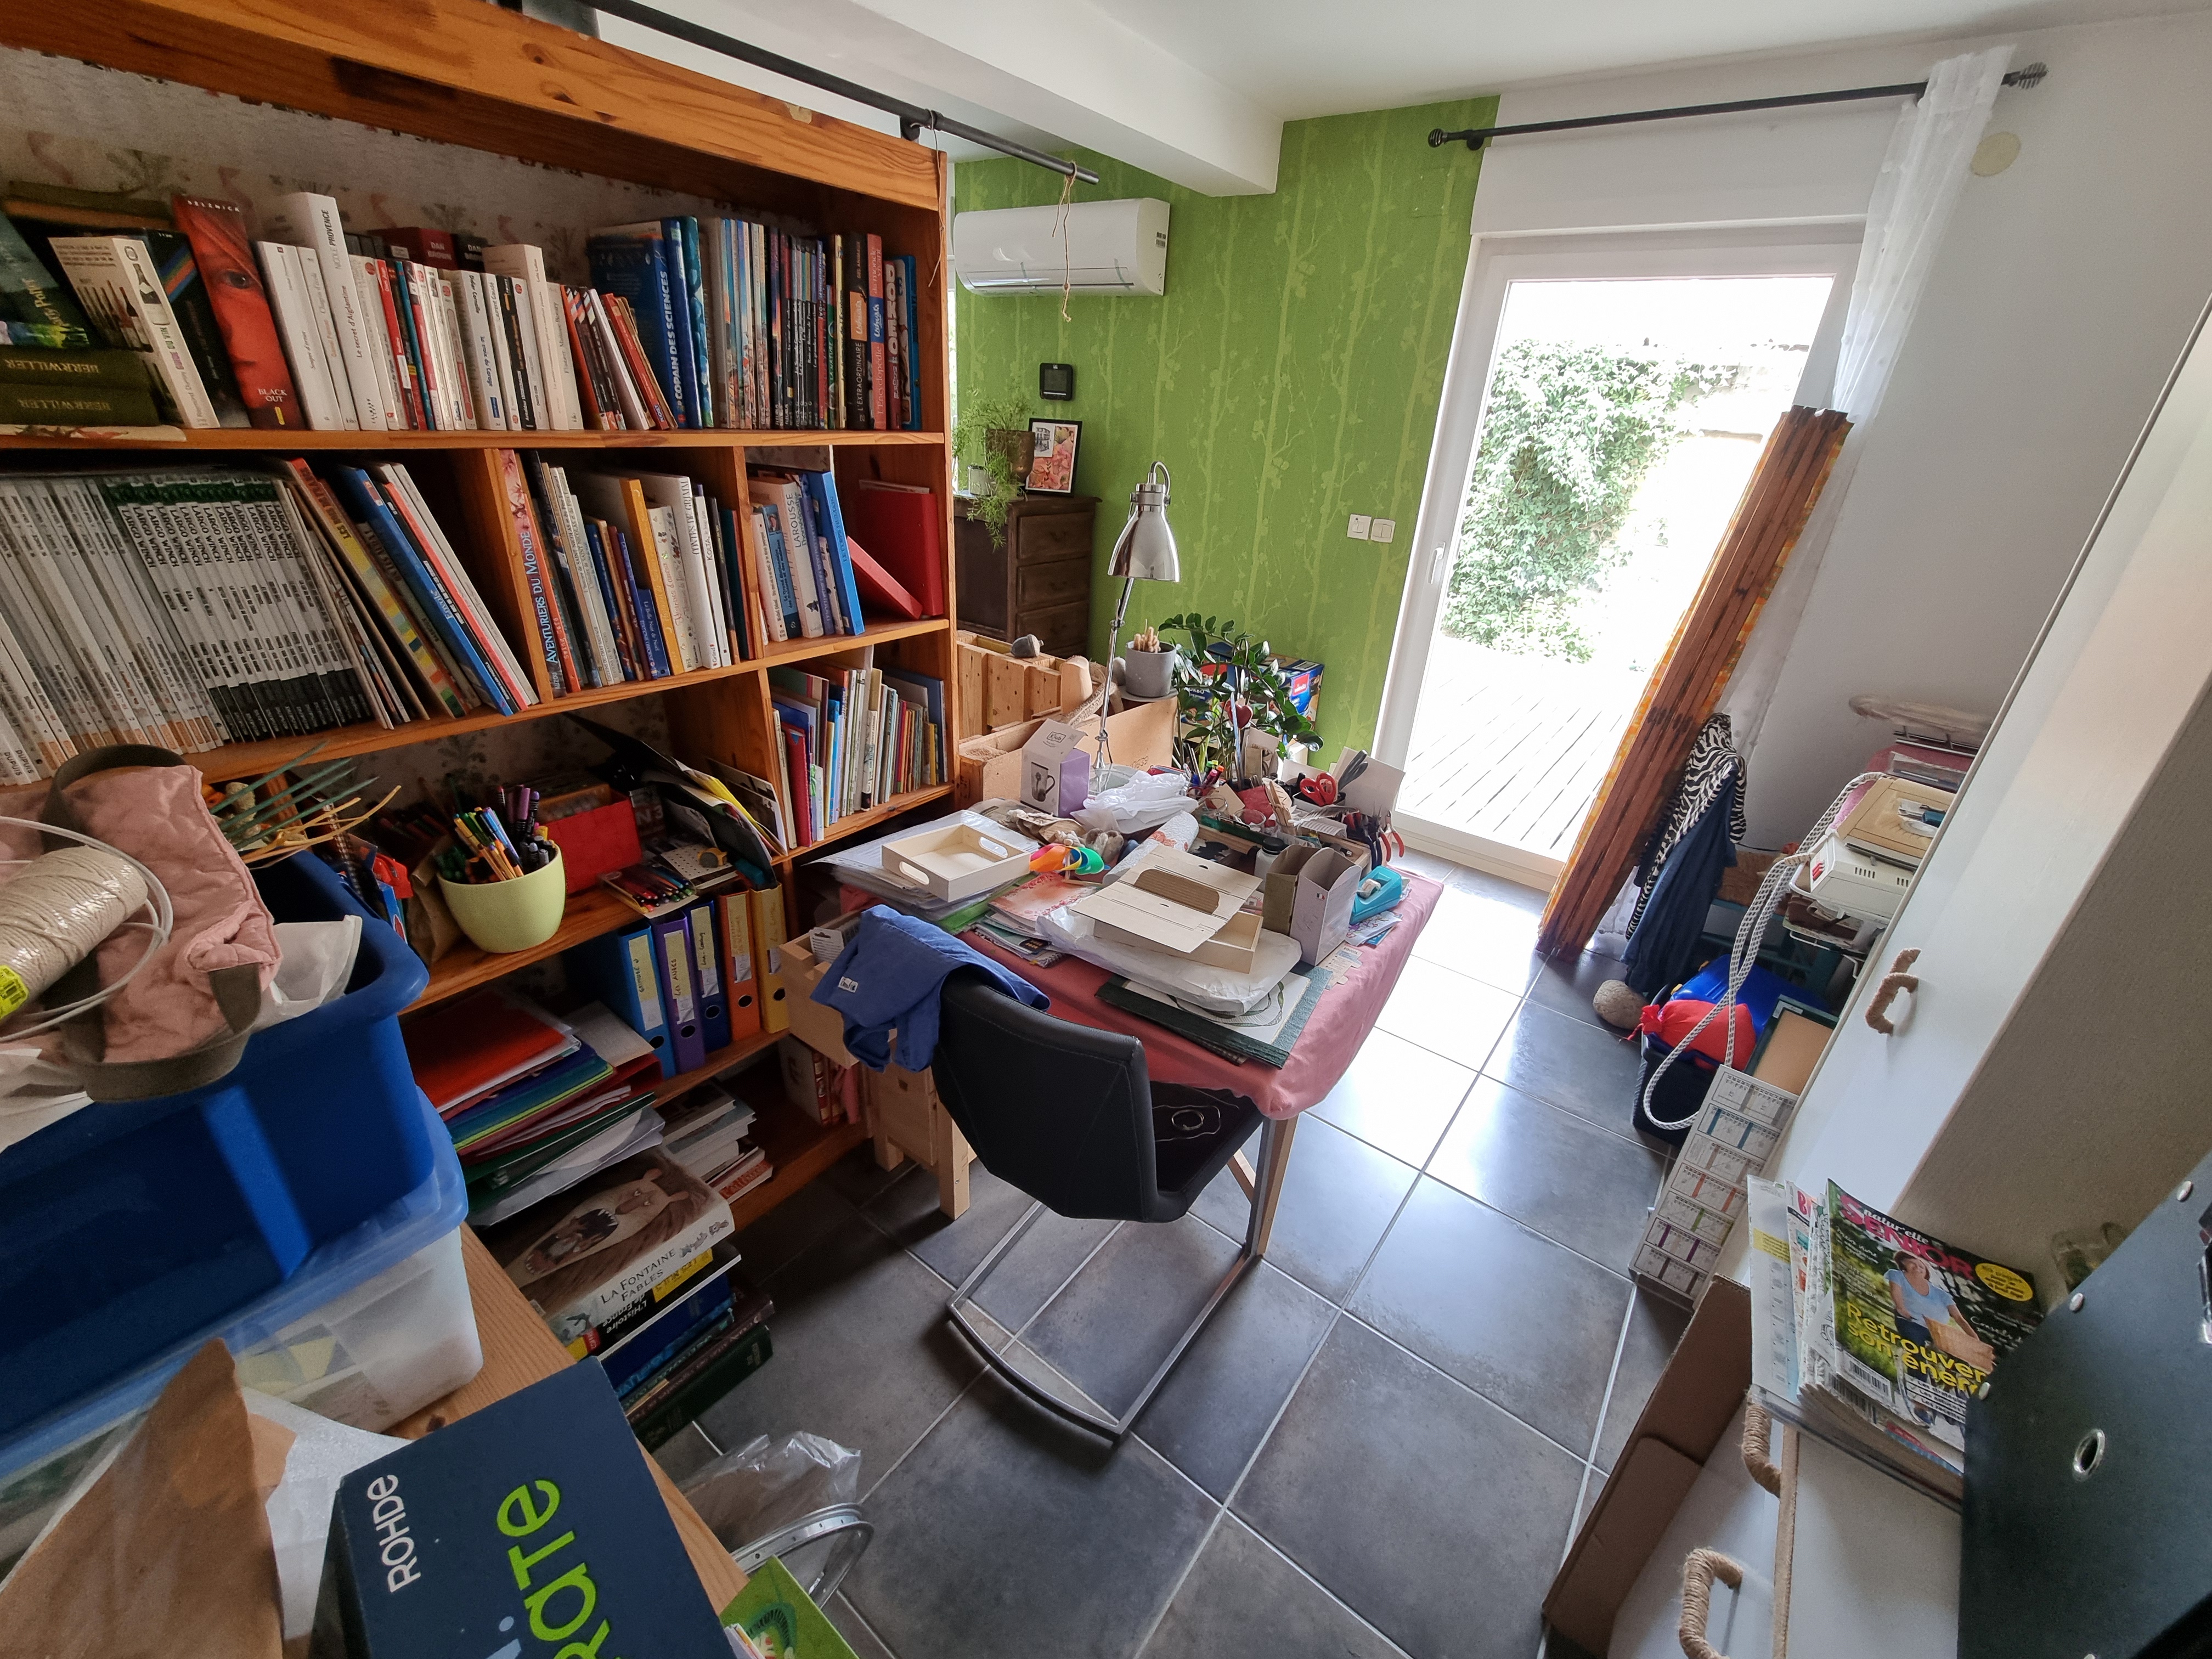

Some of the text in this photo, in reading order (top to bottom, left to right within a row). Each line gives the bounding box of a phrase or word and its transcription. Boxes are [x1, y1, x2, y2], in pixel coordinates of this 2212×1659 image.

[319, 207, 342, 270] NICOLE PROVENCE
[427, 250, 452, 261] BROWN
[430, 241, 445, 250] DAN
[467, 244, 482, 252] DAN
[19, 275, 51, 312] Potter
[468, 274, 477, 291] Didier
[351, 328, 361, 349] secret
[356, 349, 363, 358] Le
[658, 269, 684, 400] COPAIN DES SCIENCES
[854, 342, 864, 411] L'EXTRAORDINAIRE
[121, 507, 156, 569] LARGO WINCH
[132, 505, 167, 567] LARGO WINCH
[145, 507, 180, 569] LARGO WINCH
[155, 504, 190, 565] LARGO WINCH
[170, 507, 202, 568] LARGO WINCH
[179, 505, 212, 565] LARGO WINCH
[191, 504, 223, 563] LARGO WINCH
[203, 506, 234, 565] LARGO WINCH
[215, 504, 246, 563] LARGO WINCH
[223, 504, 254, 562] LARGO WINCH
[233, 502, 263, 561] LARGO WINCH
[246, 505, 277, 563] LARGO WINCH
[254, 502, 284, 560] LARGO WINCH
[263, 503, 295, 560] LARGO WINCH
[272, 503, 303, 559] LARGO WINCH
[679, 480, 701, 555] CONTES DE GRIMM
[781, 493, 805, 549] LAROUSSE
[429, 590, 454, 621] Envols
[517, 530, 558, 665] AVENTURIERS DU MONDE
[3, 749, 22, 778] DUPUIS
[14, 747, 34, 776] DUPUIS
[1839, 1194, 1975, 1281] SENIOR
[599, 1247, 678, 1305] LA FONTAINE
[619, 1268, 665, 1302] FABLES
[603, 1299, 650, 1335] L'Histoire
[1847, 1301, 1986, 1383] Retrouver
[1848, 1321, 1892, 1357] son
